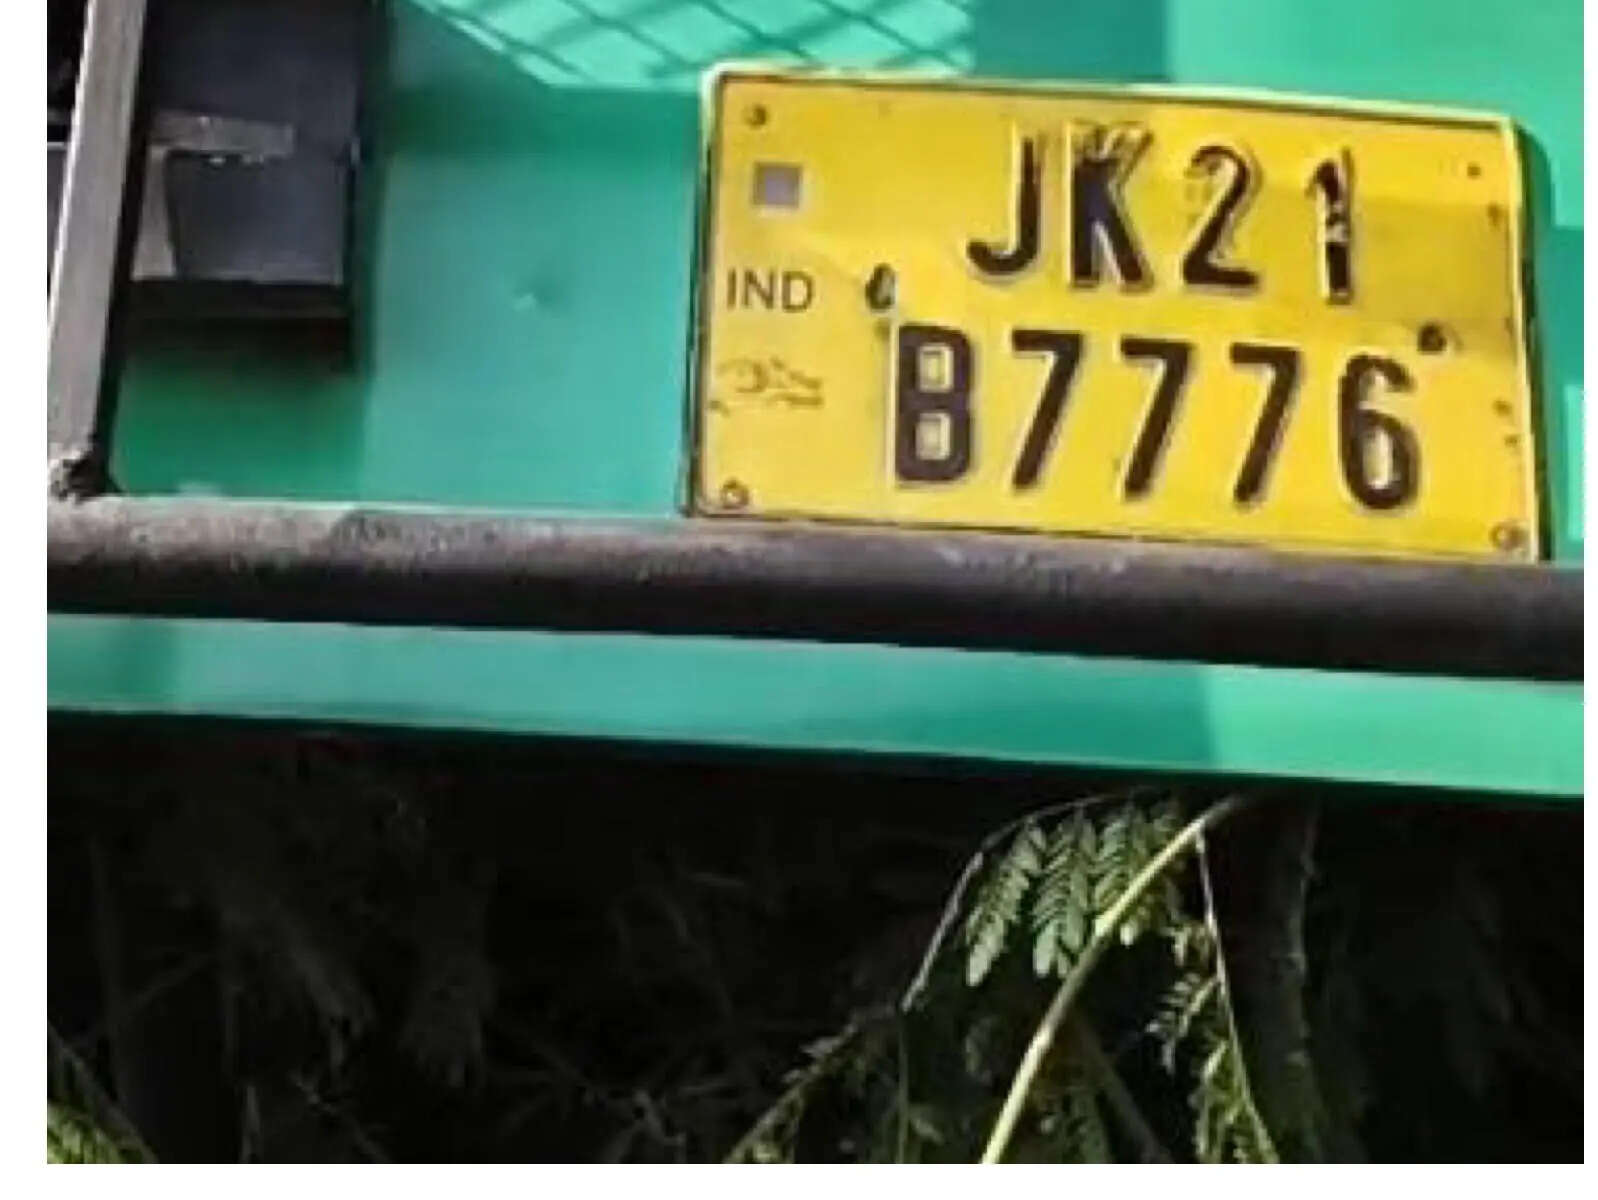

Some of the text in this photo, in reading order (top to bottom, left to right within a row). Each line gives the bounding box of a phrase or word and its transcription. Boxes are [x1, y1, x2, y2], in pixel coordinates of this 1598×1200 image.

[726, 267, 815, 314] IND
[967, 122, 1354, 306] JK21
[895, 322, 1420, 511] B7776
